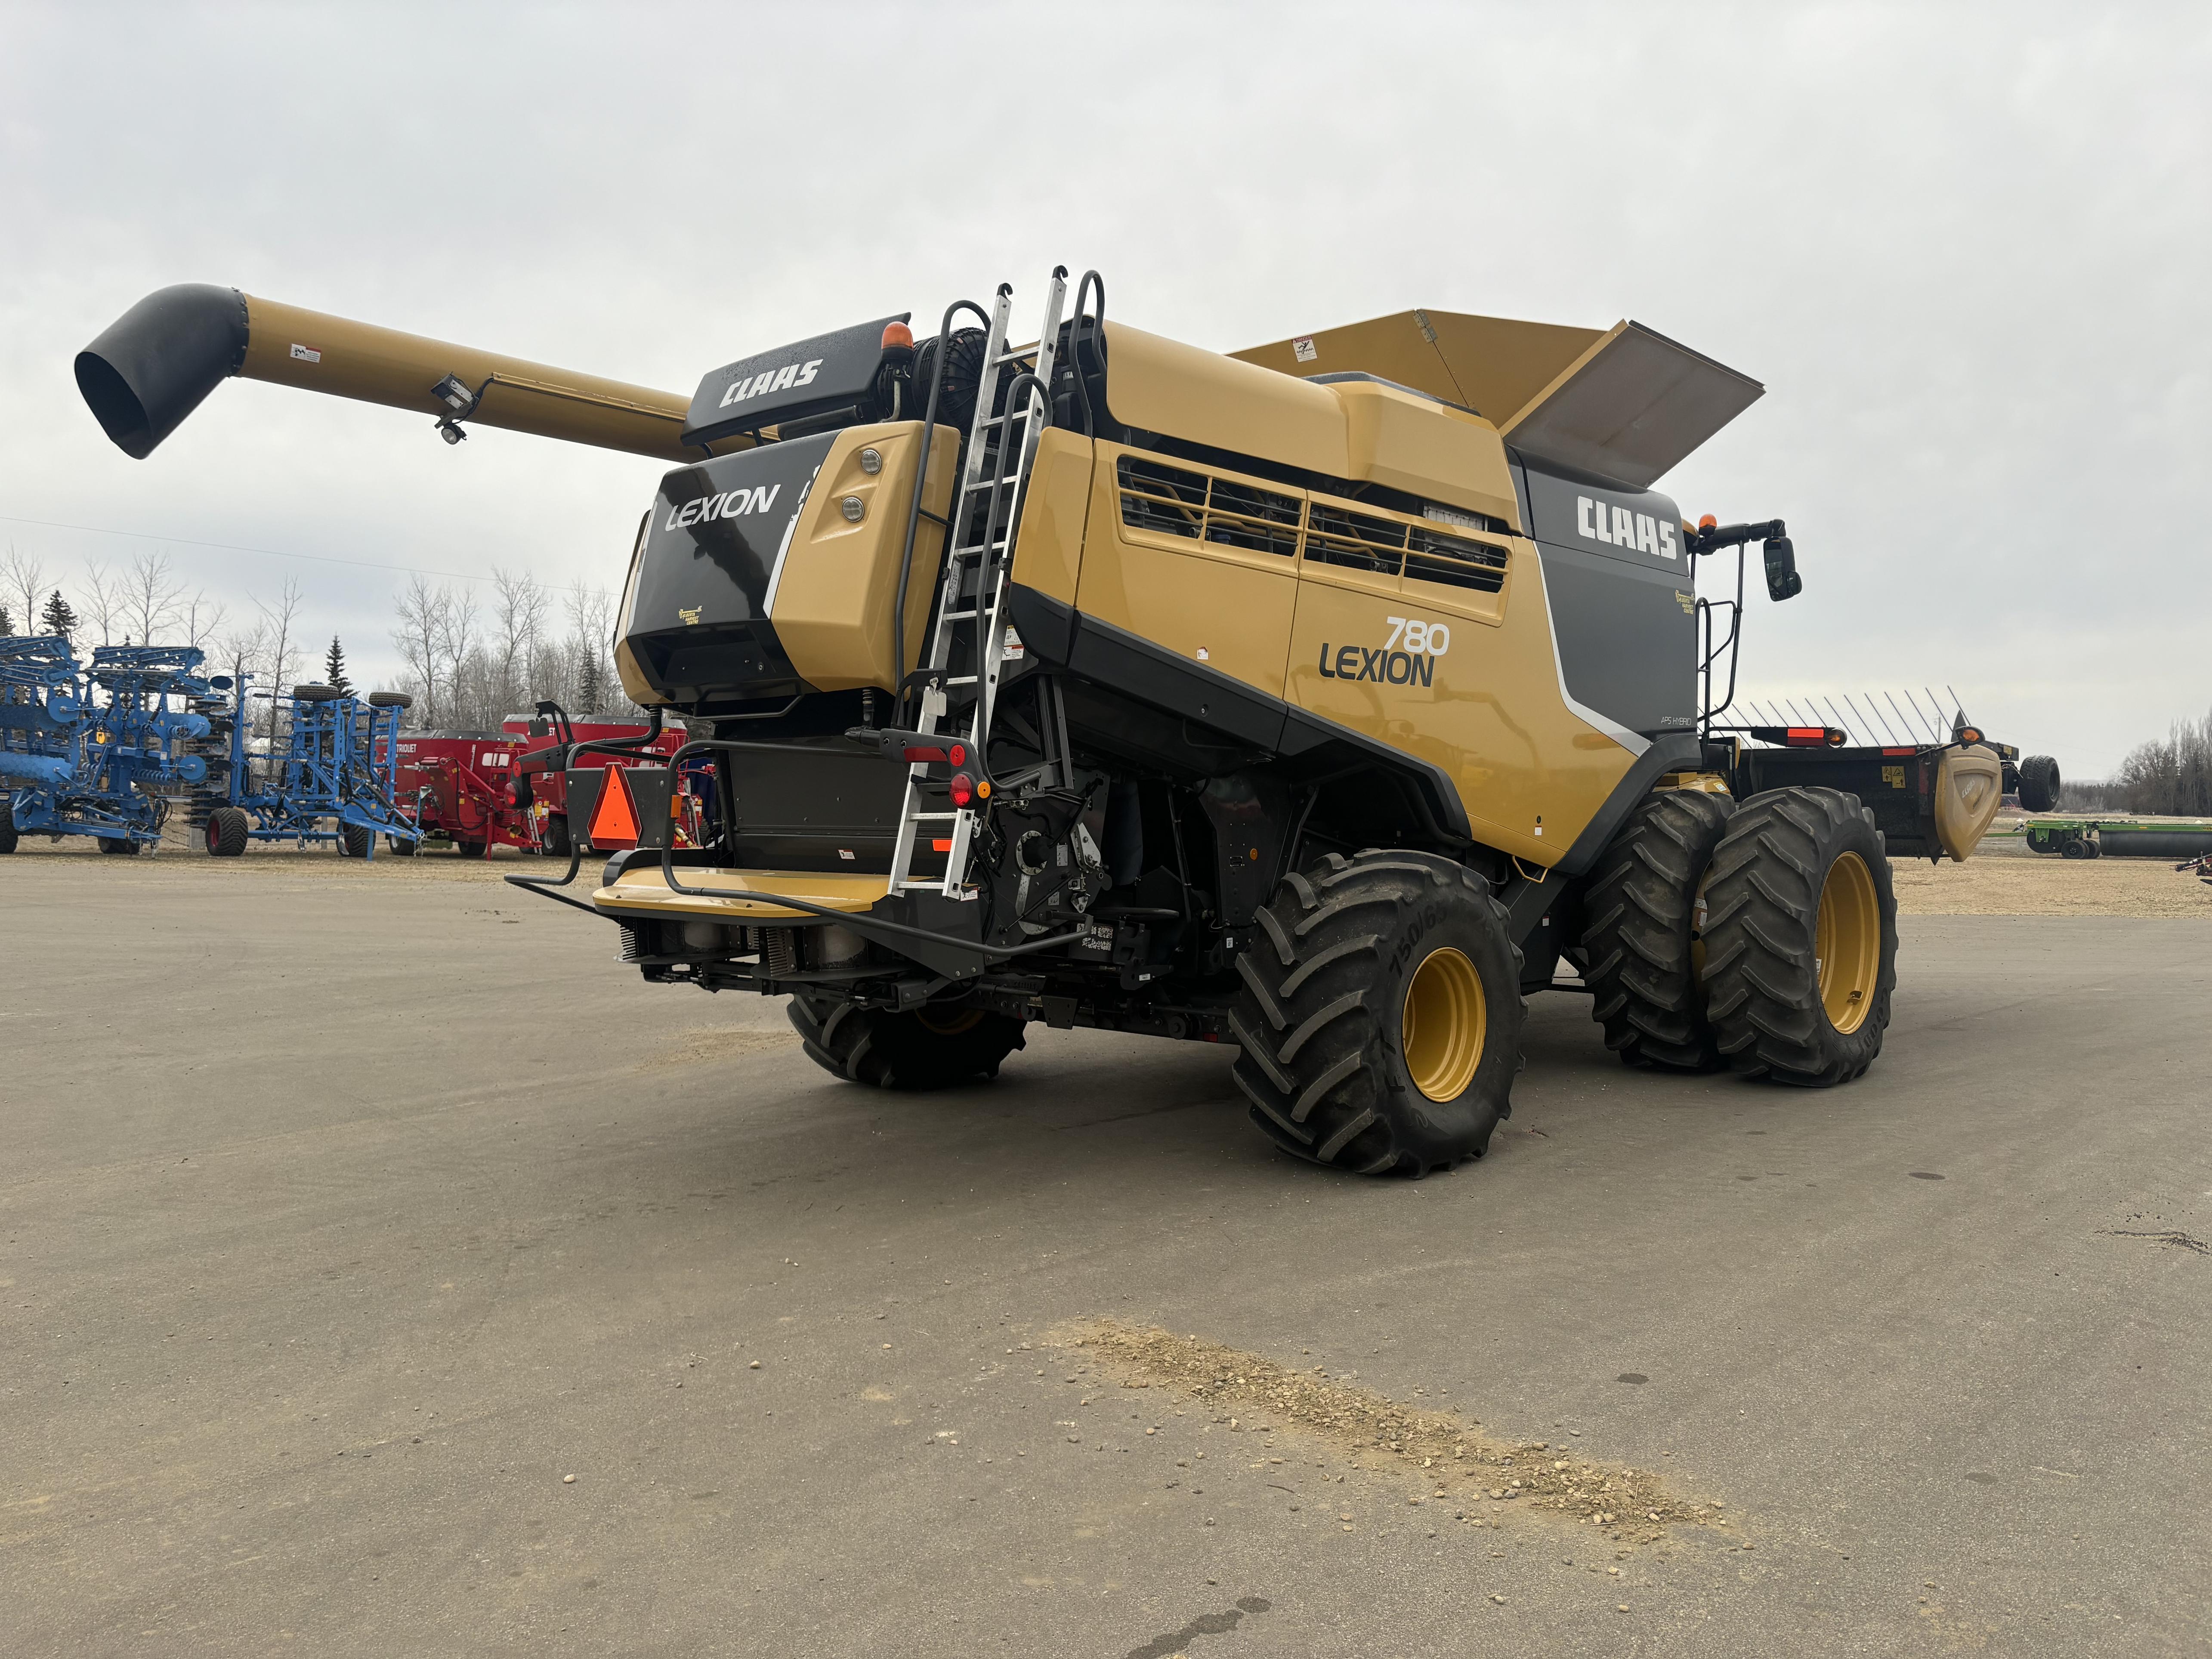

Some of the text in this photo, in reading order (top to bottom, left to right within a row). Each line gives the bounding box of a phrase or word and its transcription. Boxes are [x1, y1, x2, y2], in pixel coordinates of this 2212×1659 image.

[719, 359, 824, 408] CLAAS
[665, 484, 781, 531] LEXION
[1578, 496, 1678, 560] CLAAS
[1384, 616, 1450, 656] 780
[1319, 643, 1435, 688] LEXION
[1661, 716, 1692, 726] APS HYBRID
[396, 744, 417, 753] TRIOLIET
